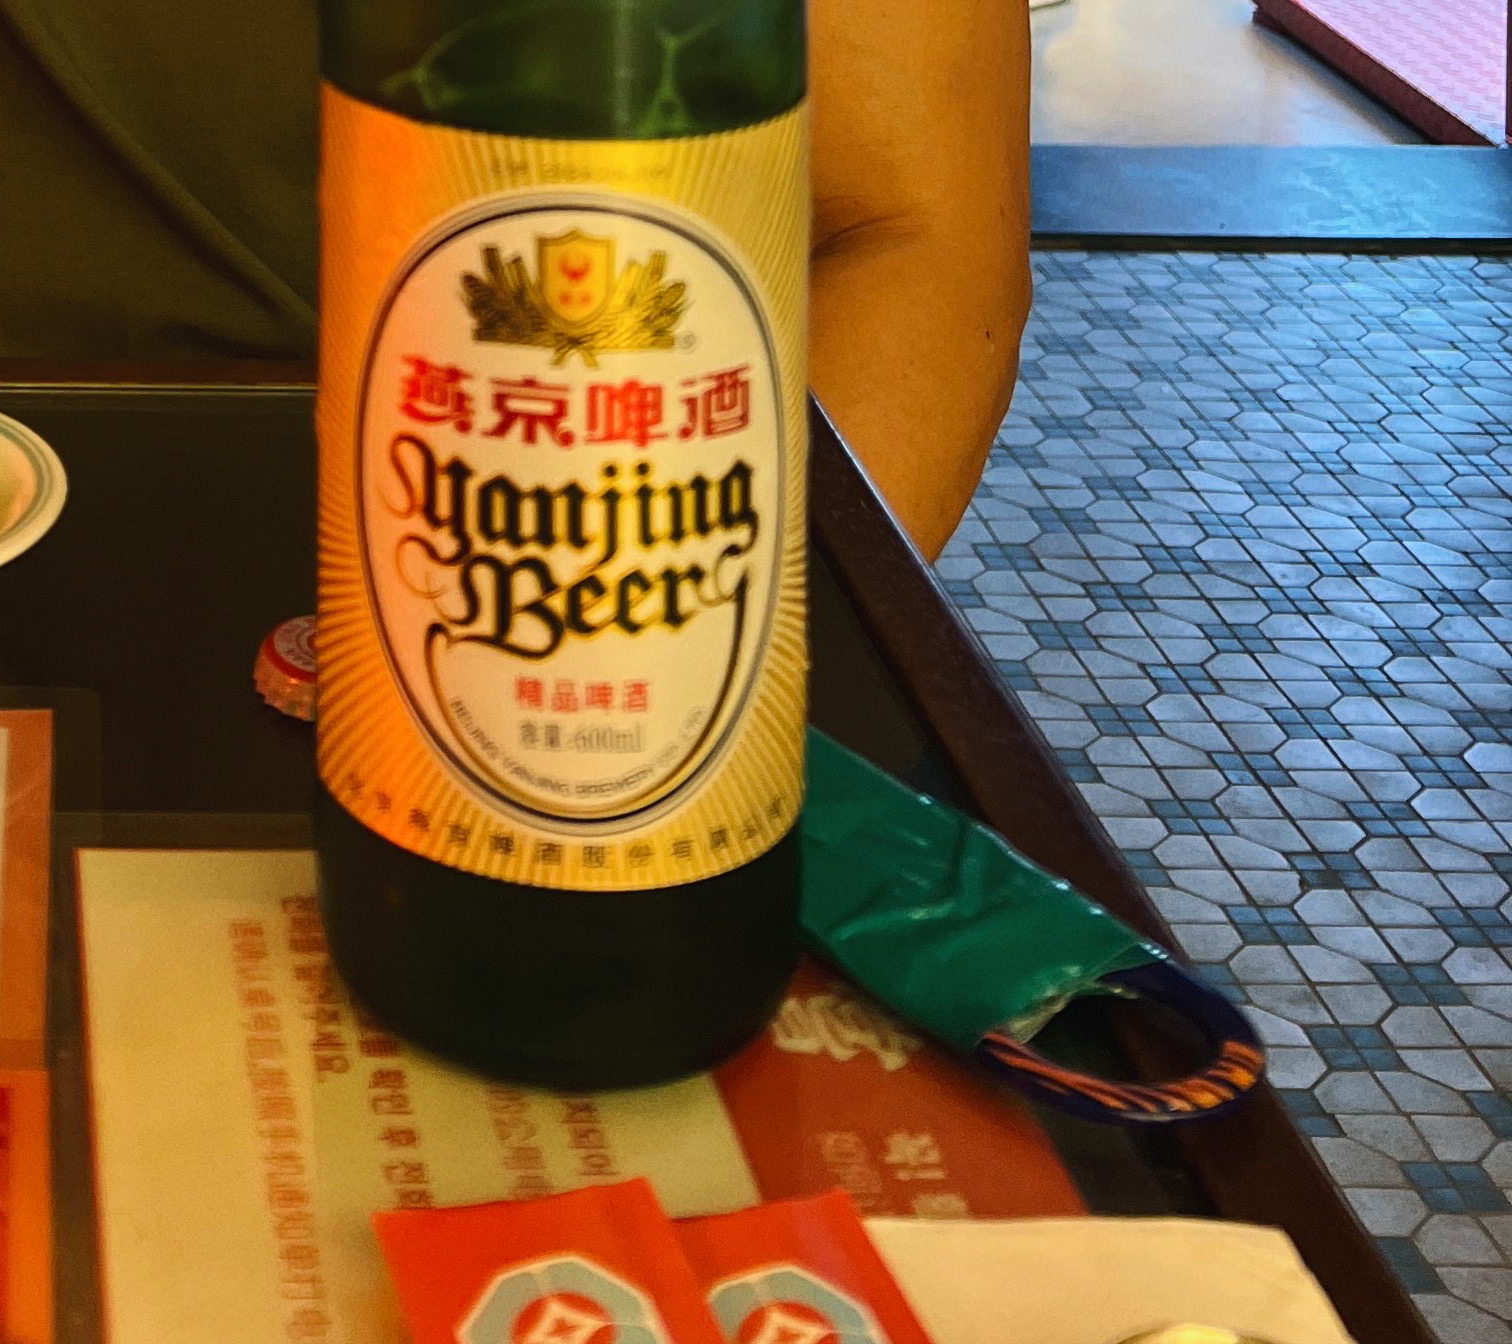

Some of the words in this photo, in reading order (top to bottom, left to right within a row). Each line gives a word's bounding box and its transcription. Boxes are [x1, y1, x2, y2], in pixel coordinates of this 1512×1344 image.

[399, 354, 753, 449] 燕京啤酒
[385, 430, 761, 563] Yanjing
[400, 534, 748, 658] Beer
[515, 676, 649, 712] 精品啤酒
